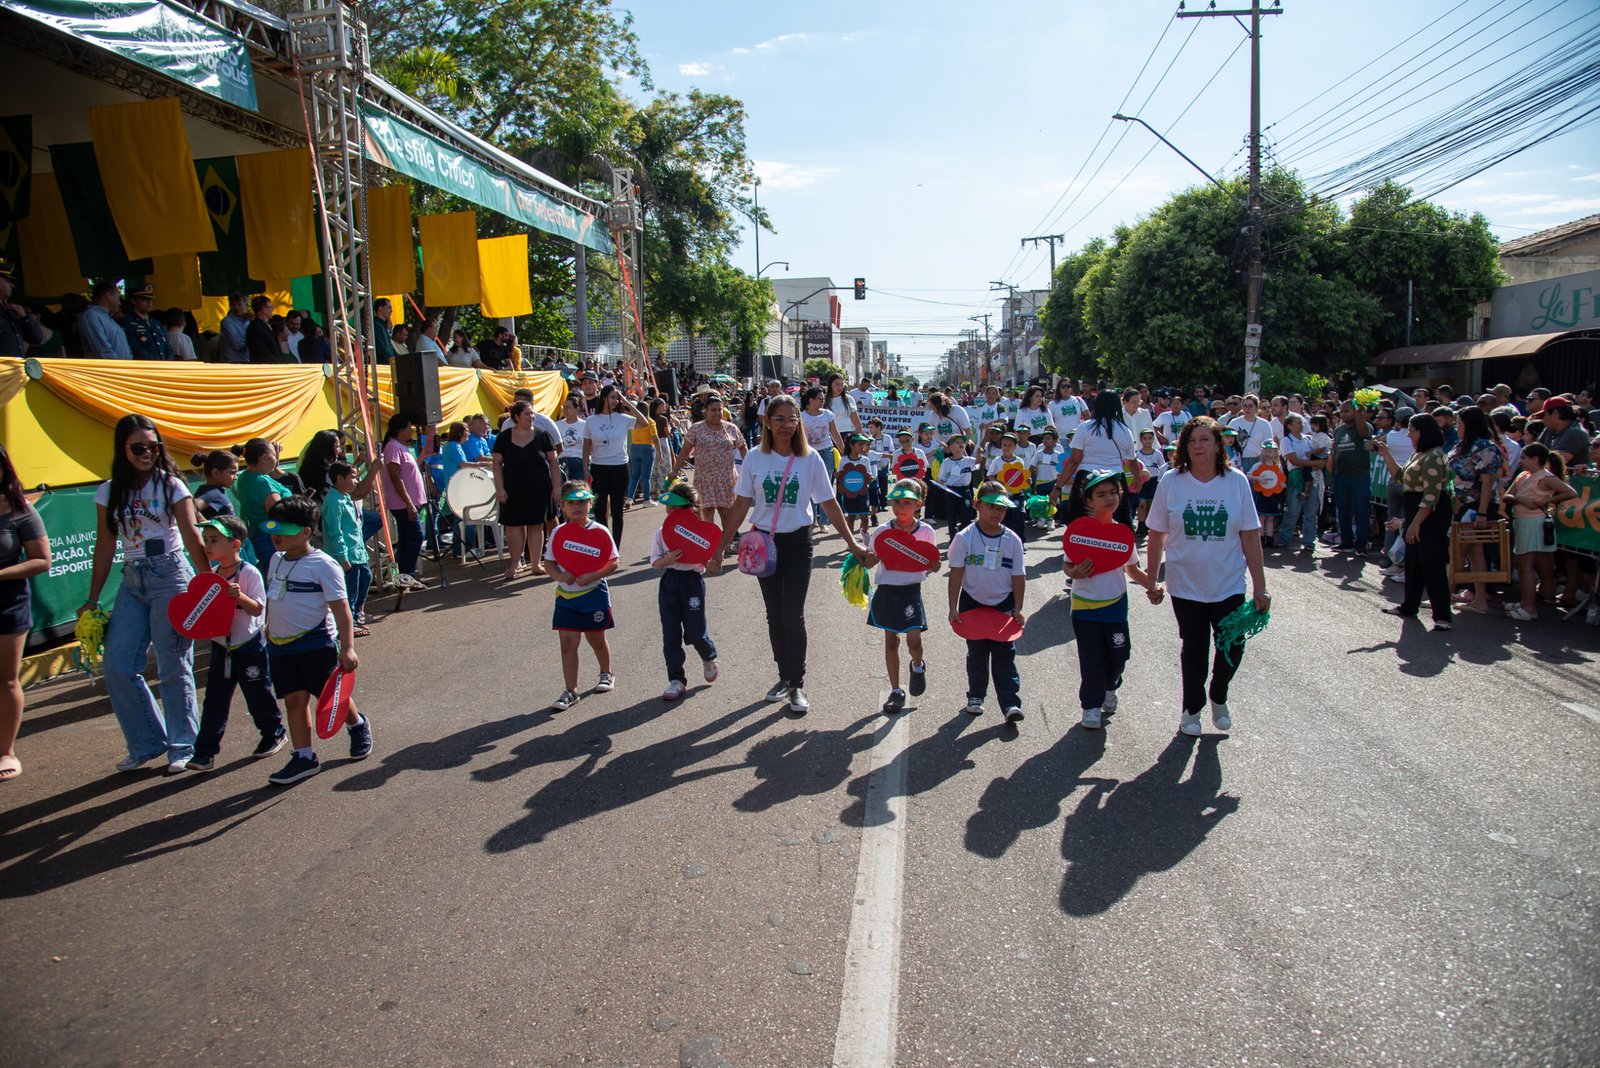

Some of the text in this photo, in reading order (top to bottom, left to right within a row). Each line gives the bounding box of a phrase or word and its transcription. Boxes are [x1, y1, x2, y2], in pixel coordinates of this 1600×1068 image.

[384, 127, 435, 171] Desfile
[807, 342, 830, 350] Preço
[65, 530, 98, 545] MUNIC
[674, 524, 711, 549] COMPAIXÃO
[1070, 535, 1129, 551] CONSIDERAÇÃO
[564, 542, 601, 557] ESPERANÇA
[886, 538, 929, 564] ACOLHIMENTO
[48, 559, 94, 578] ESPORTE
[184, 584, 221, 631] COMPREENSÃO
